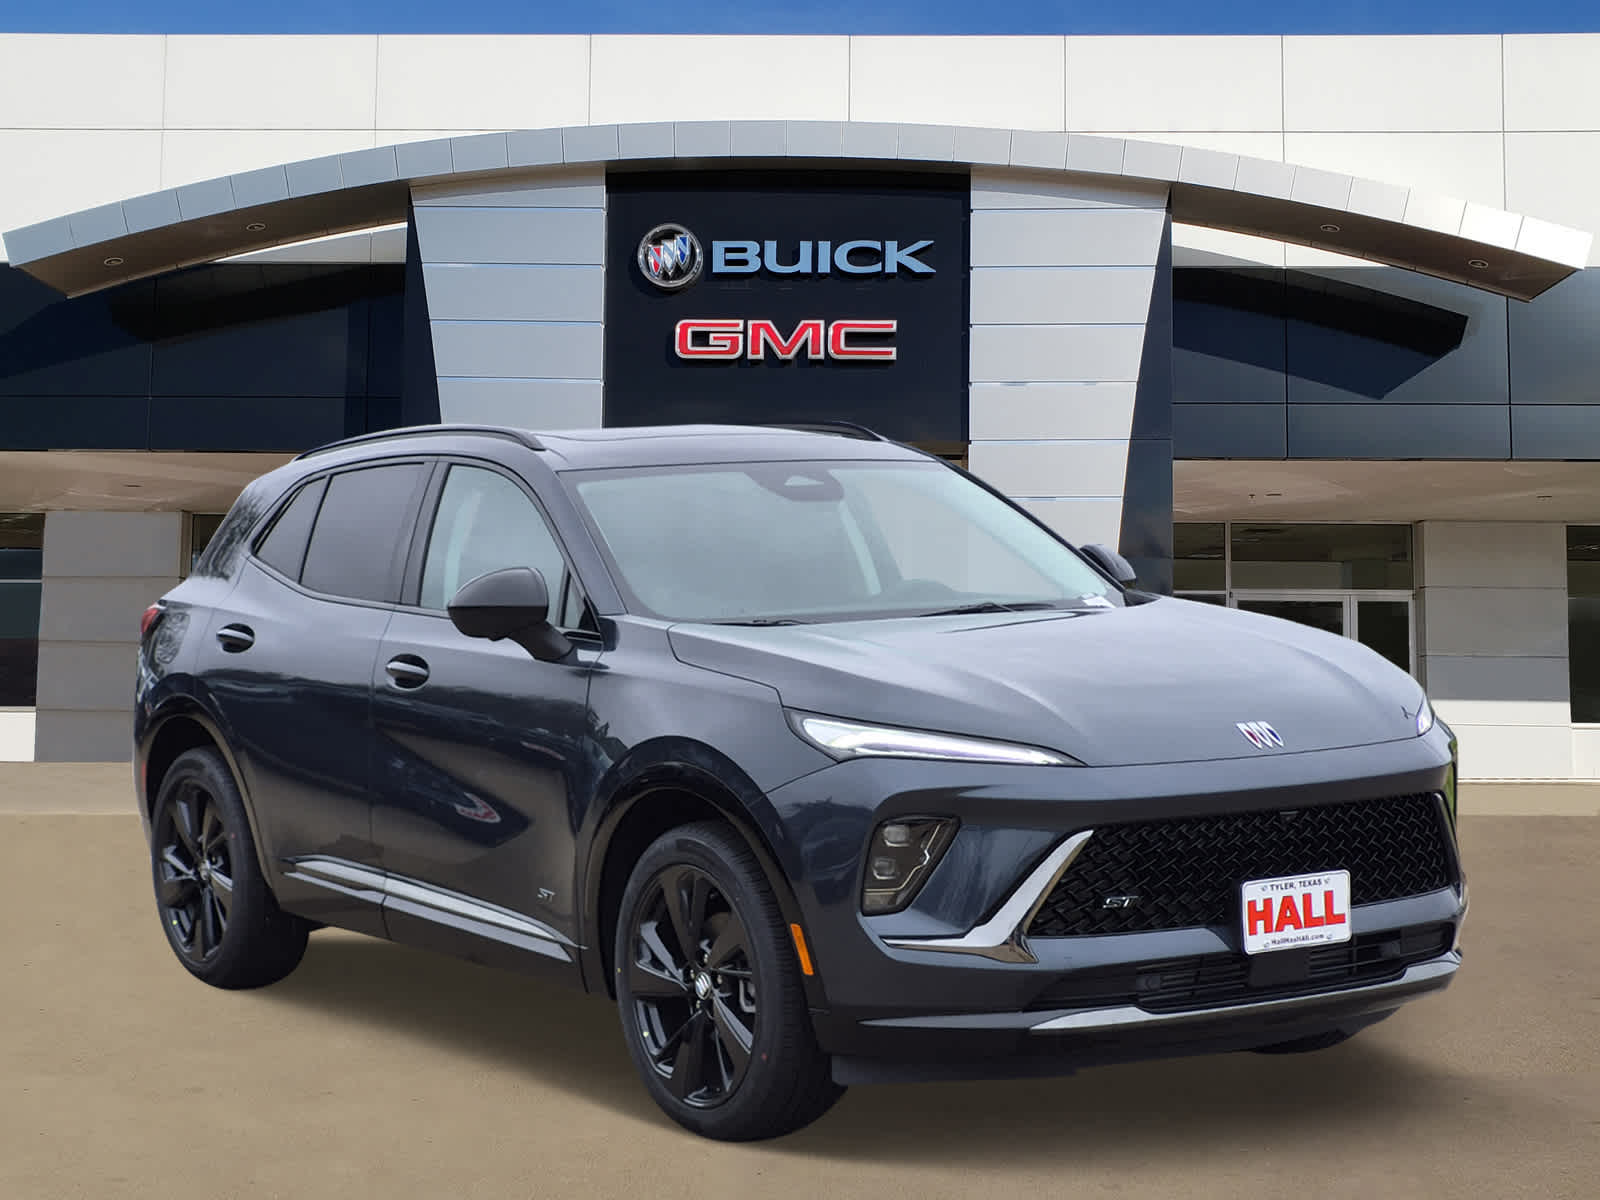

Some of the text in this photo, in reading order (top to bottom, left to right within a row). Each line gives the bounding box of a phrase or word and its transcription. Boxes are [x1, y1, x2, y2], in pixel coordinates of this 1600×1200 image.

[712, 240, 937, 273] BUICK
[674, 319, 897, 360] GMC
[1270, 878, 1321, 891] TYLER, TEXAS
[1103, 895, 1139, 908] ST
[1247, 890, 1346, 936] HALL
